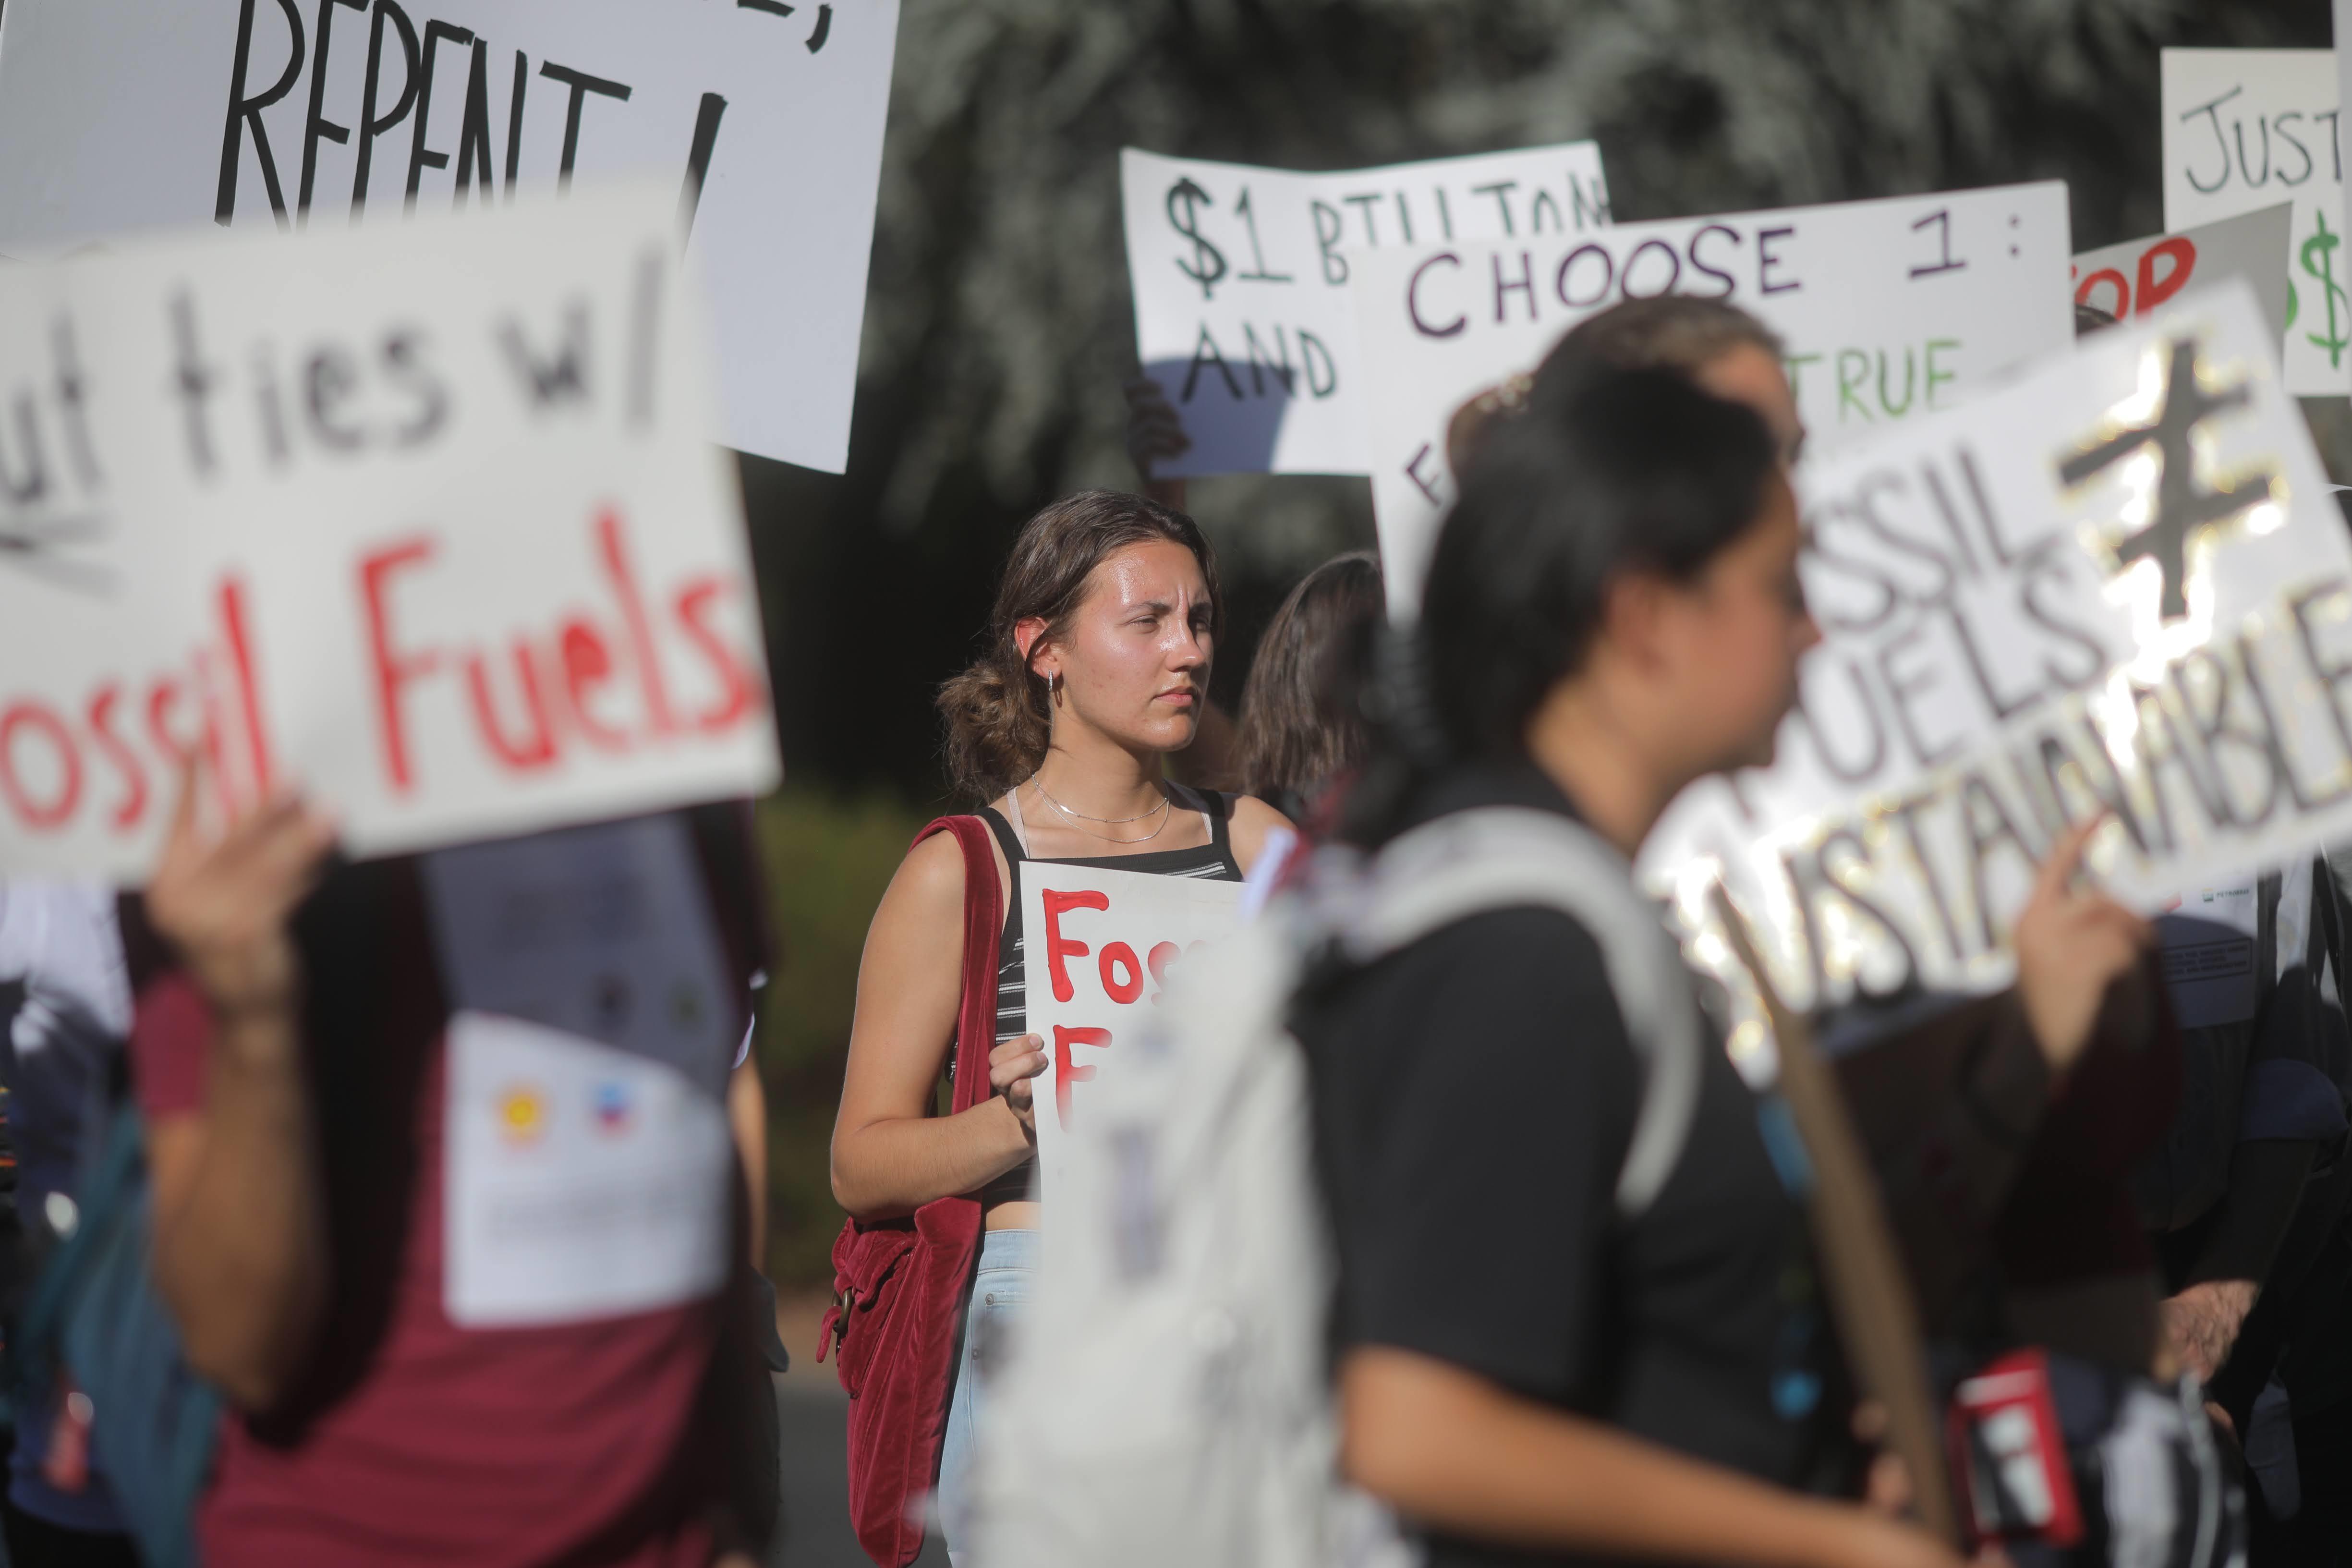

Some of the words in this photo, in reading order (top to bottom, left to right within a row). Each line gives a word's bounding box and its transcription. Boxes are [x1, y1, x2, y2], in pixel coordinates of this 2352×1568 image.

[214, 0, 632, 235] REPENT
[2180, 83, 2341, 194] JUST
[1167, 177, 1294, 299] $1
[1408, 224, 1801, 339] CHOOSE
[2070, 236, 2197, 323] OP
[168, 276, 449, 480] ties
[1181, 324, 1339, 403] AND
[1782, 339, 1963, 424] TRUE
[355, 497, 766, 800] Fuels
[1731, 552, 2108, 819] UELS
